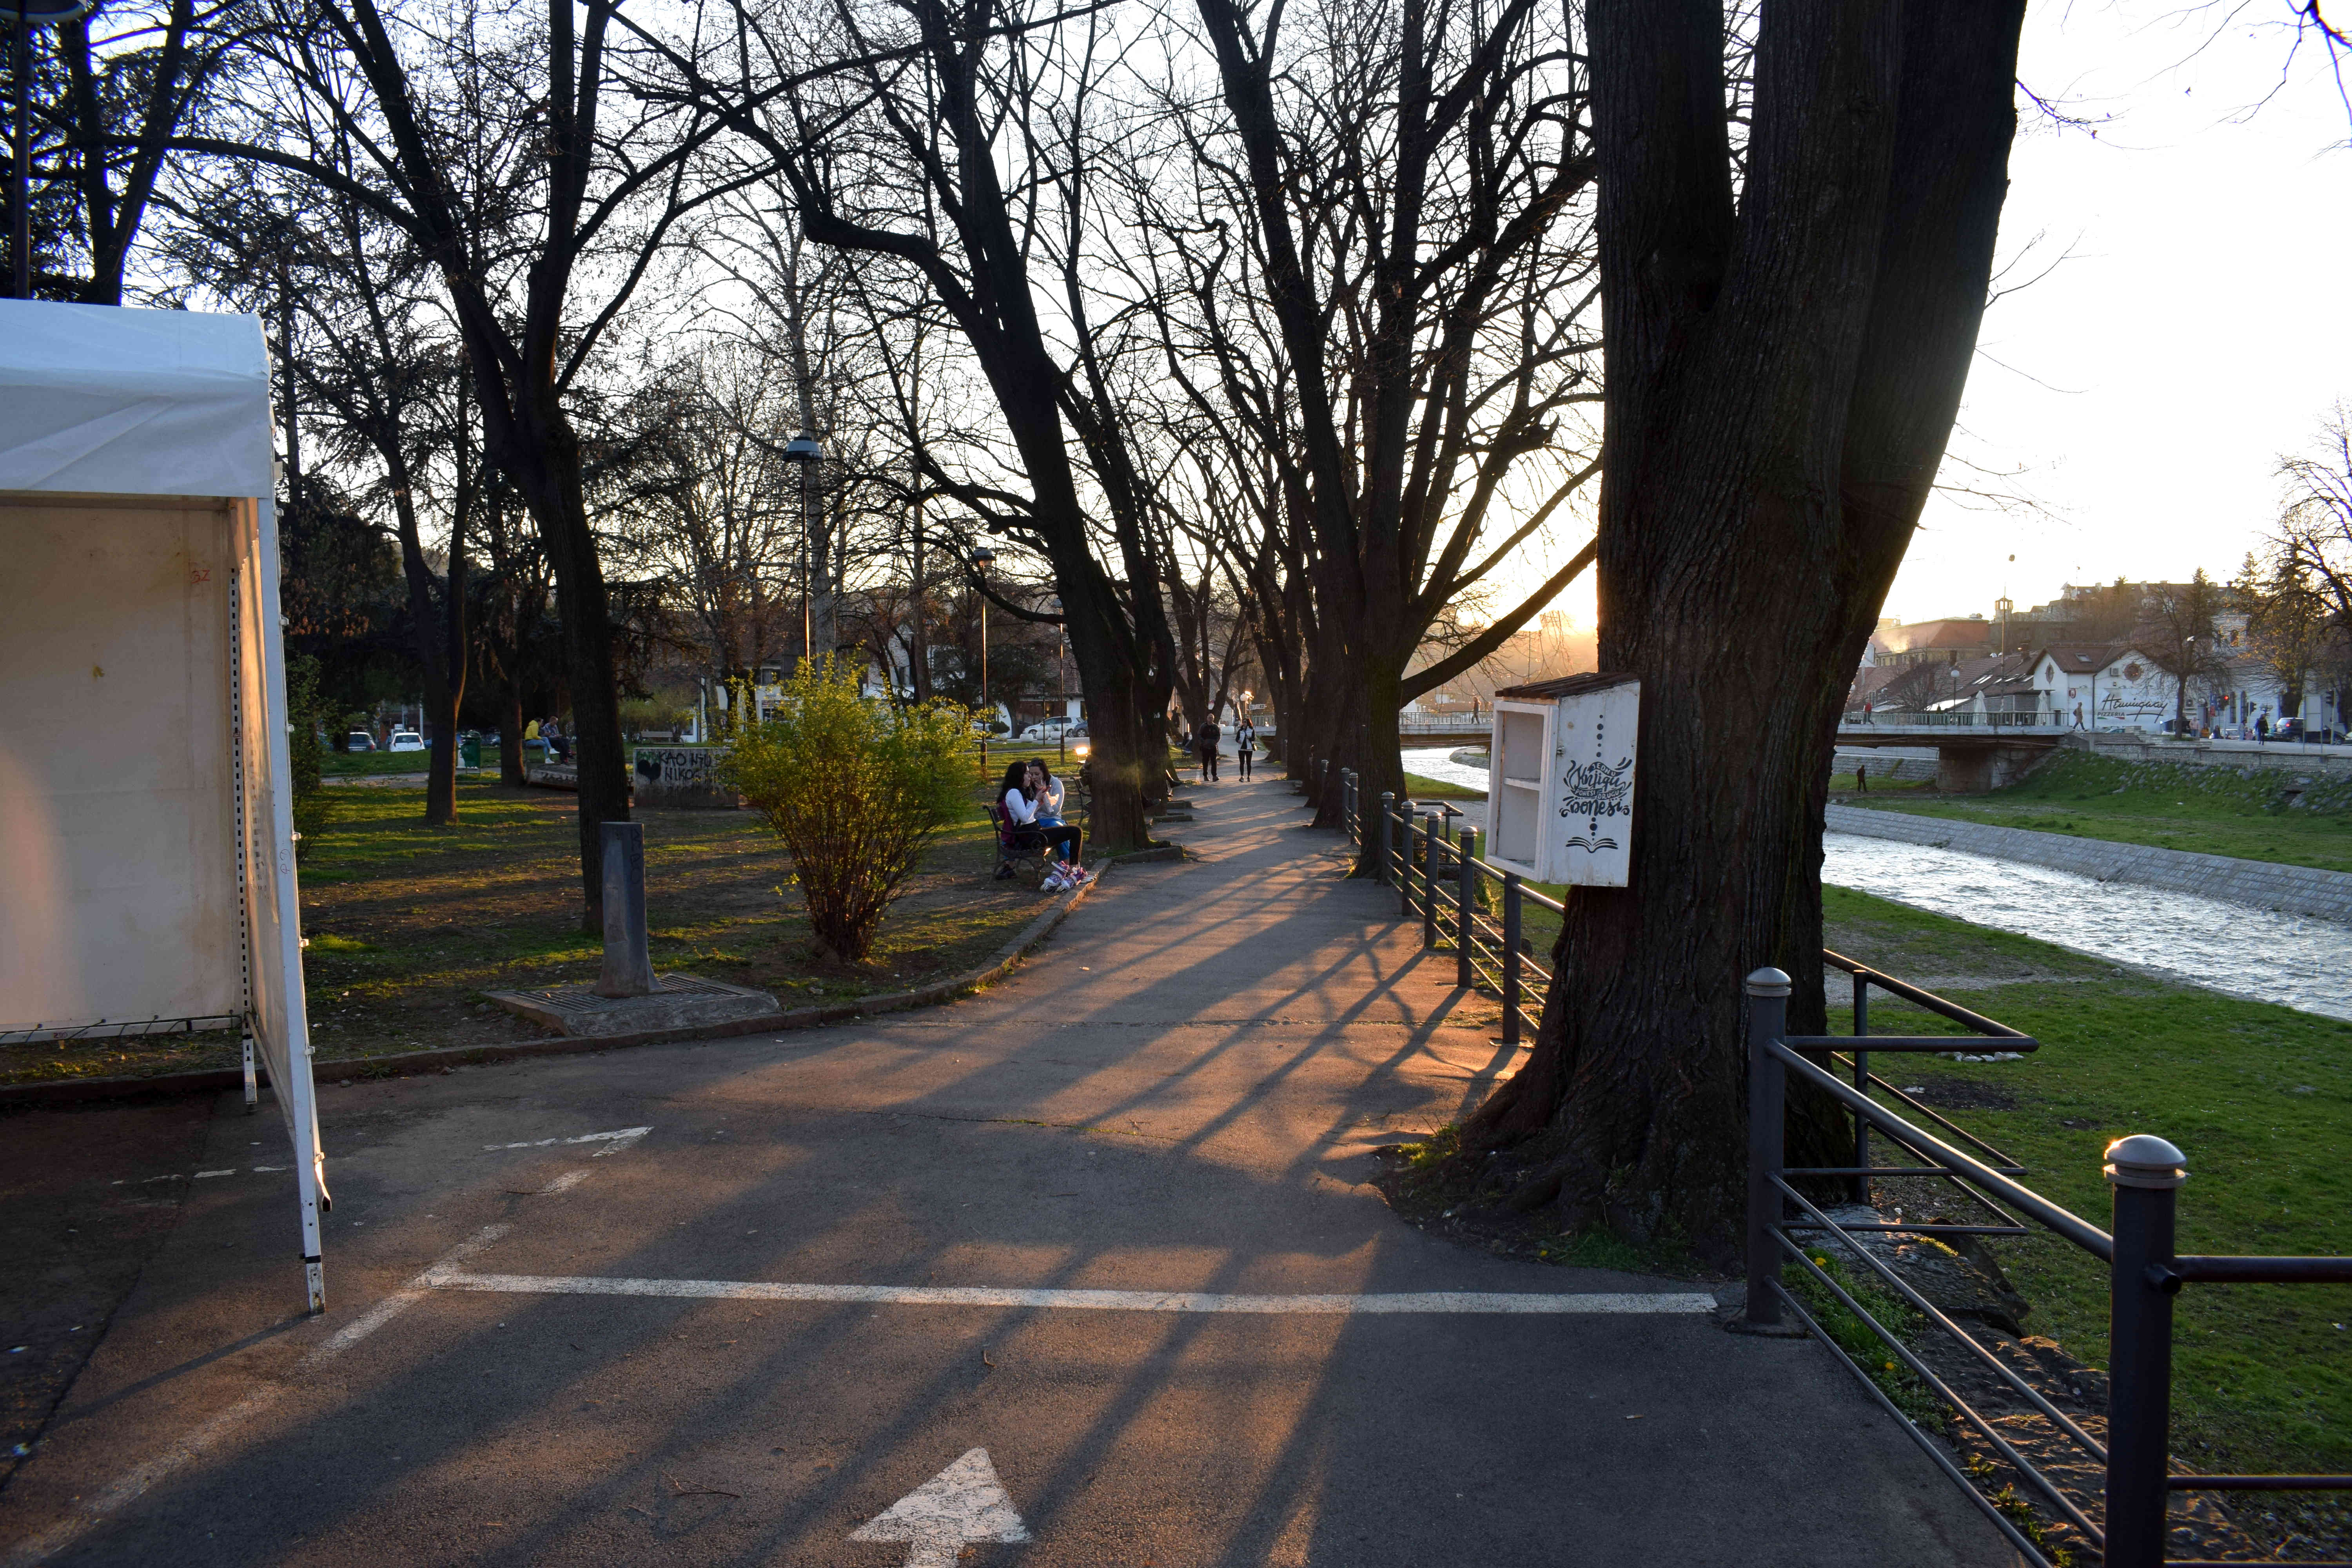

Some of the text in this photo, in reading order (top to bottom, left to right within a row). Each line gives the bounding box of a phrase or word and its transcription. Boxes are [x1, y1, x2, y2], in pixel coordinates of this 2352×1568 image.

[2102, 693, 2168, 724] Hemingway
[659, 752, 686, 766] KAO
[1592, 763, 1616, 776] JEDNU
[1569, 764, 1621, 792] Knjigu
[1597, 790, 1619, 800] DRUGU
